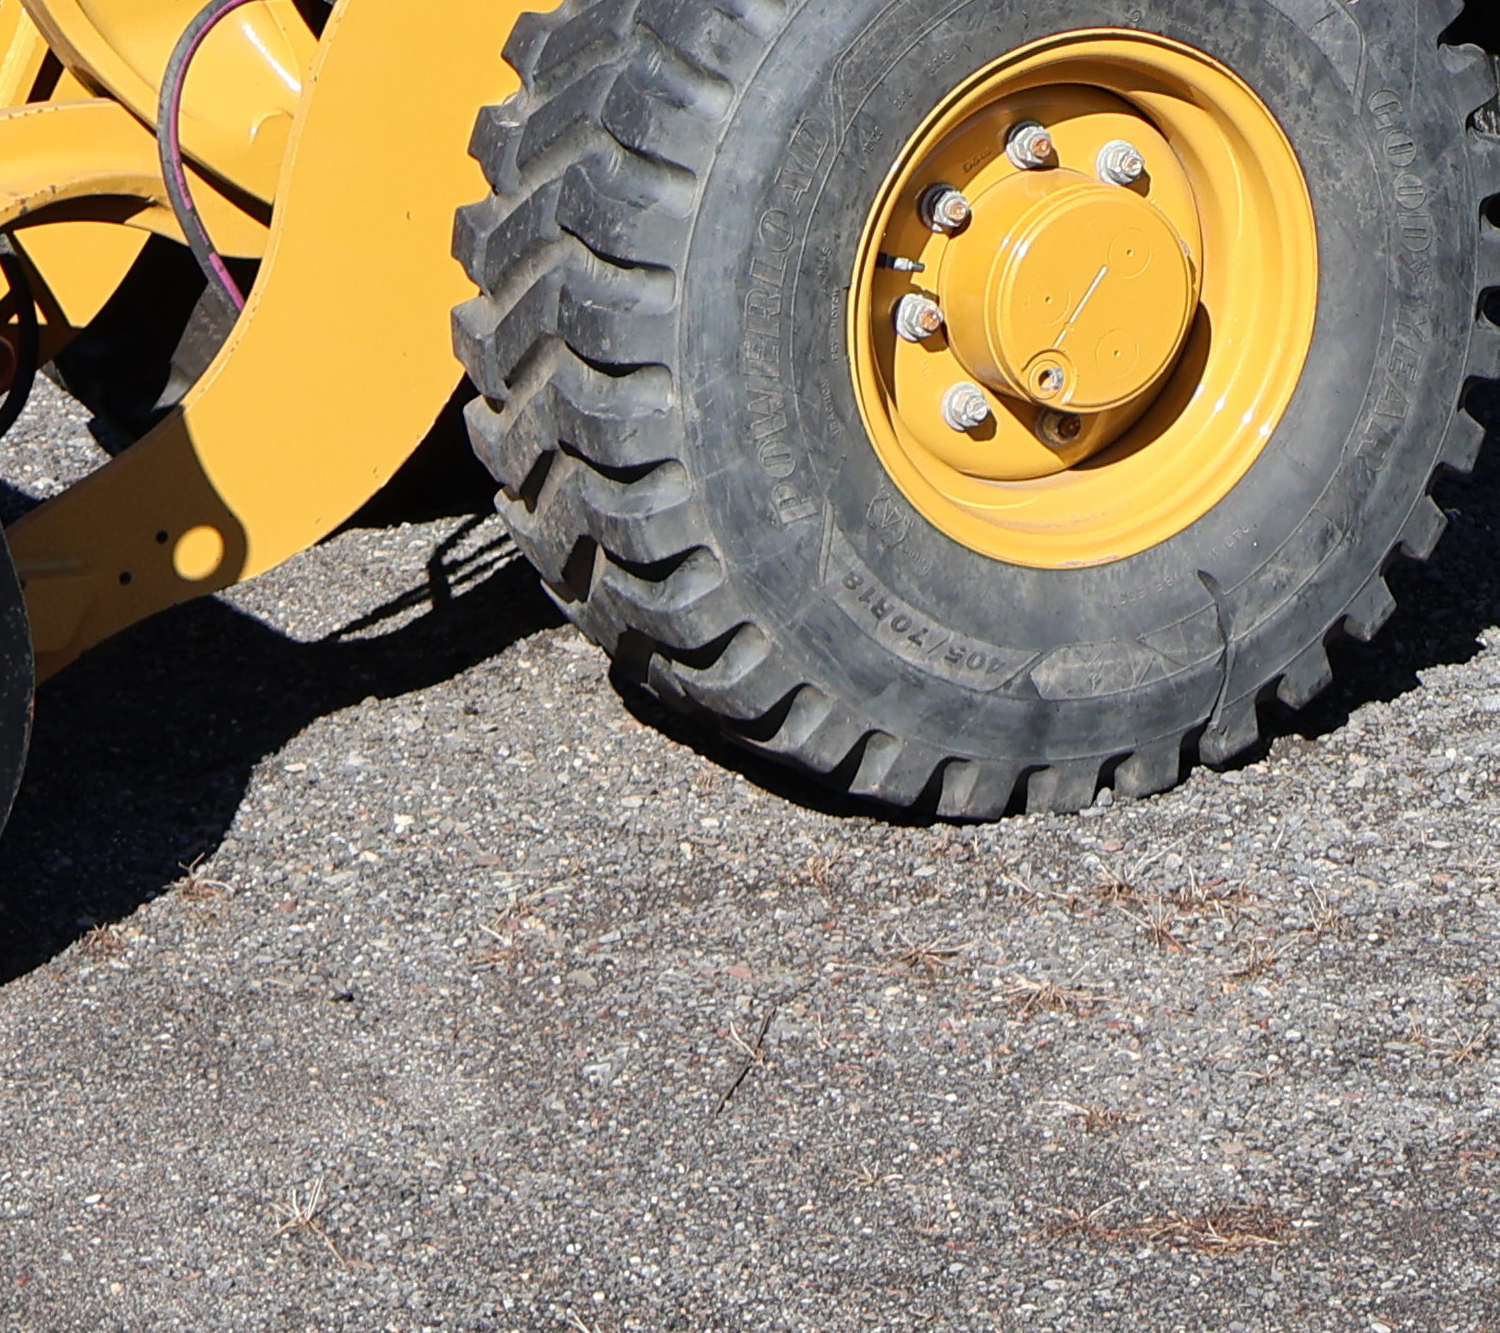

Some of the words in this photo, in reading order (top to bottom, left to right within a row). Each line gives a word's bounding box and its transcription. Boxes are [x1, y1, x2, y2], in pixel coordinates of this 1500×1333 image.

[742, 114, 831, 527] POWERLOAD
[1355, 88, 1433, 472] GOODYEAR
[841, 570, 1007, 675] 405/70R18
